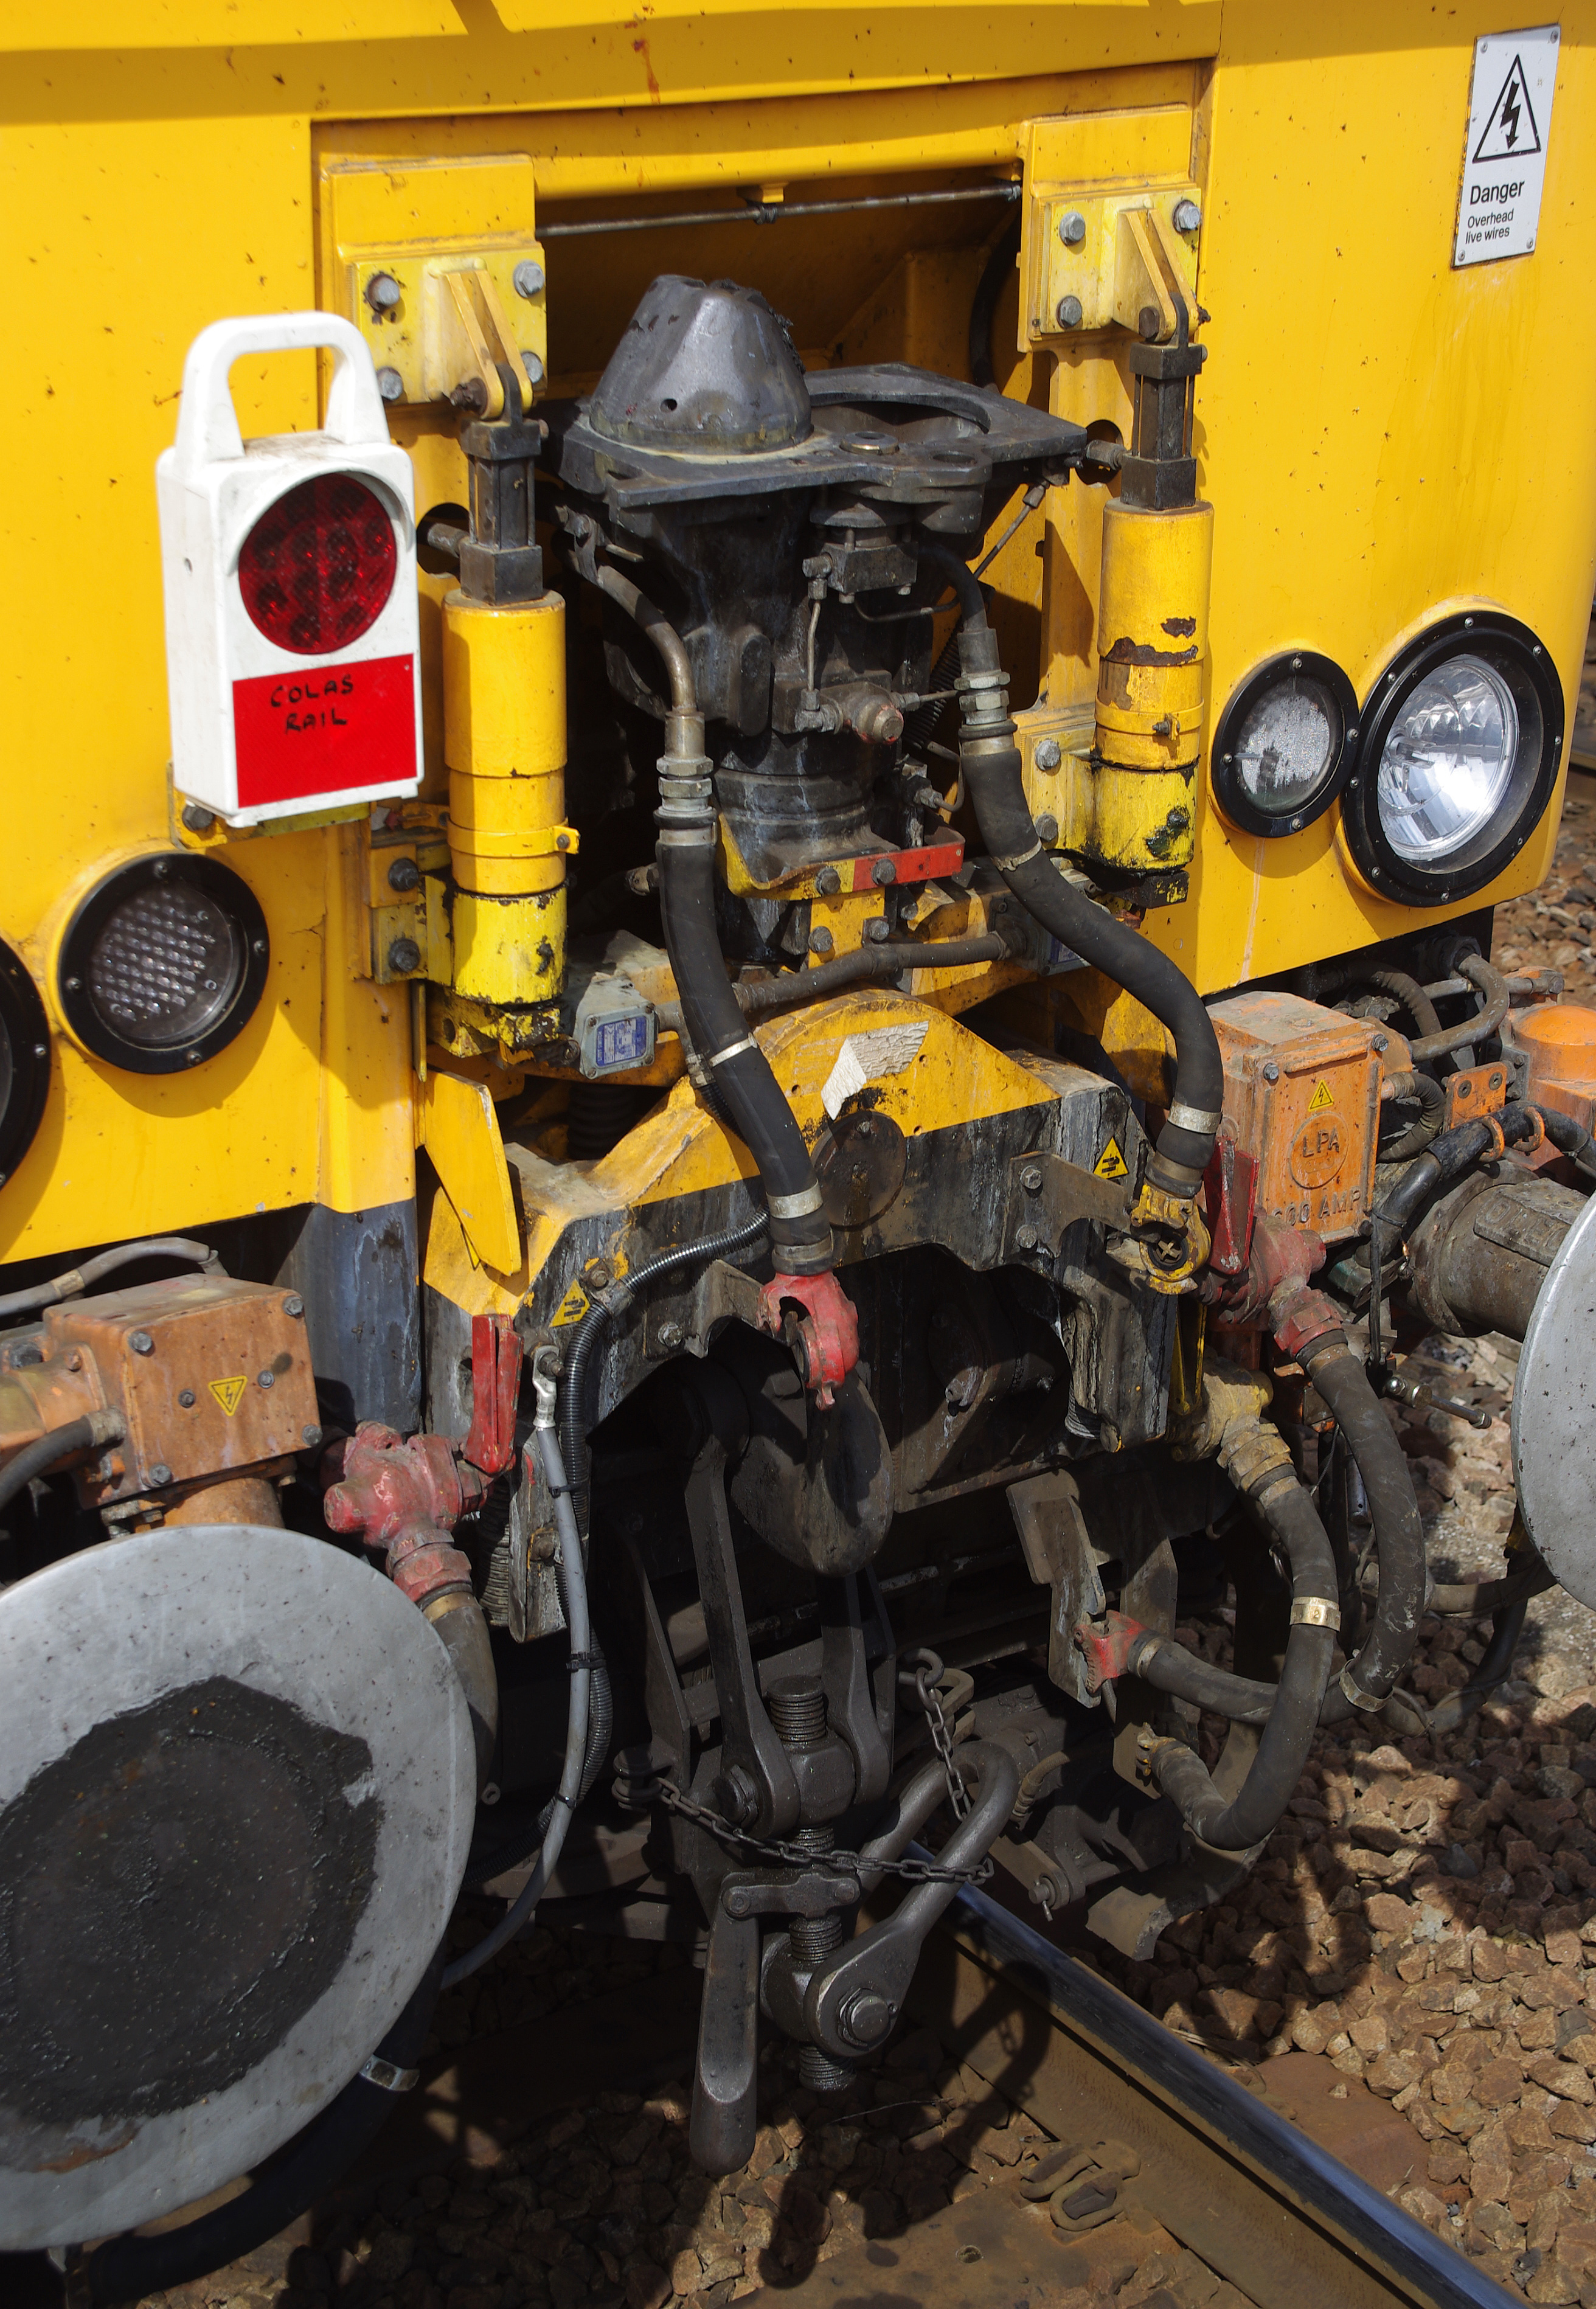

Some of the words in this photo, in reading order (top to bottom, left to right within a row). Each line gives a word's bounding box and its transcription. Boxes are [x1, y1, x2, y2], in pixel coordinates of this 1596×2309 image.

[1470, 179, 1525, 206] Danger
[1467, 208, 1514, 229] Overhead
[1465, 229, 1482, 245] live
[1485, 227, 1510, 241] wires
[270, 673, 355, 707] COLAS
[285, 707, 347, 734] RAIL
[1302, 1126, 1339, 1158] LPA
[1318, 1186, 1361, 1220] AMP
